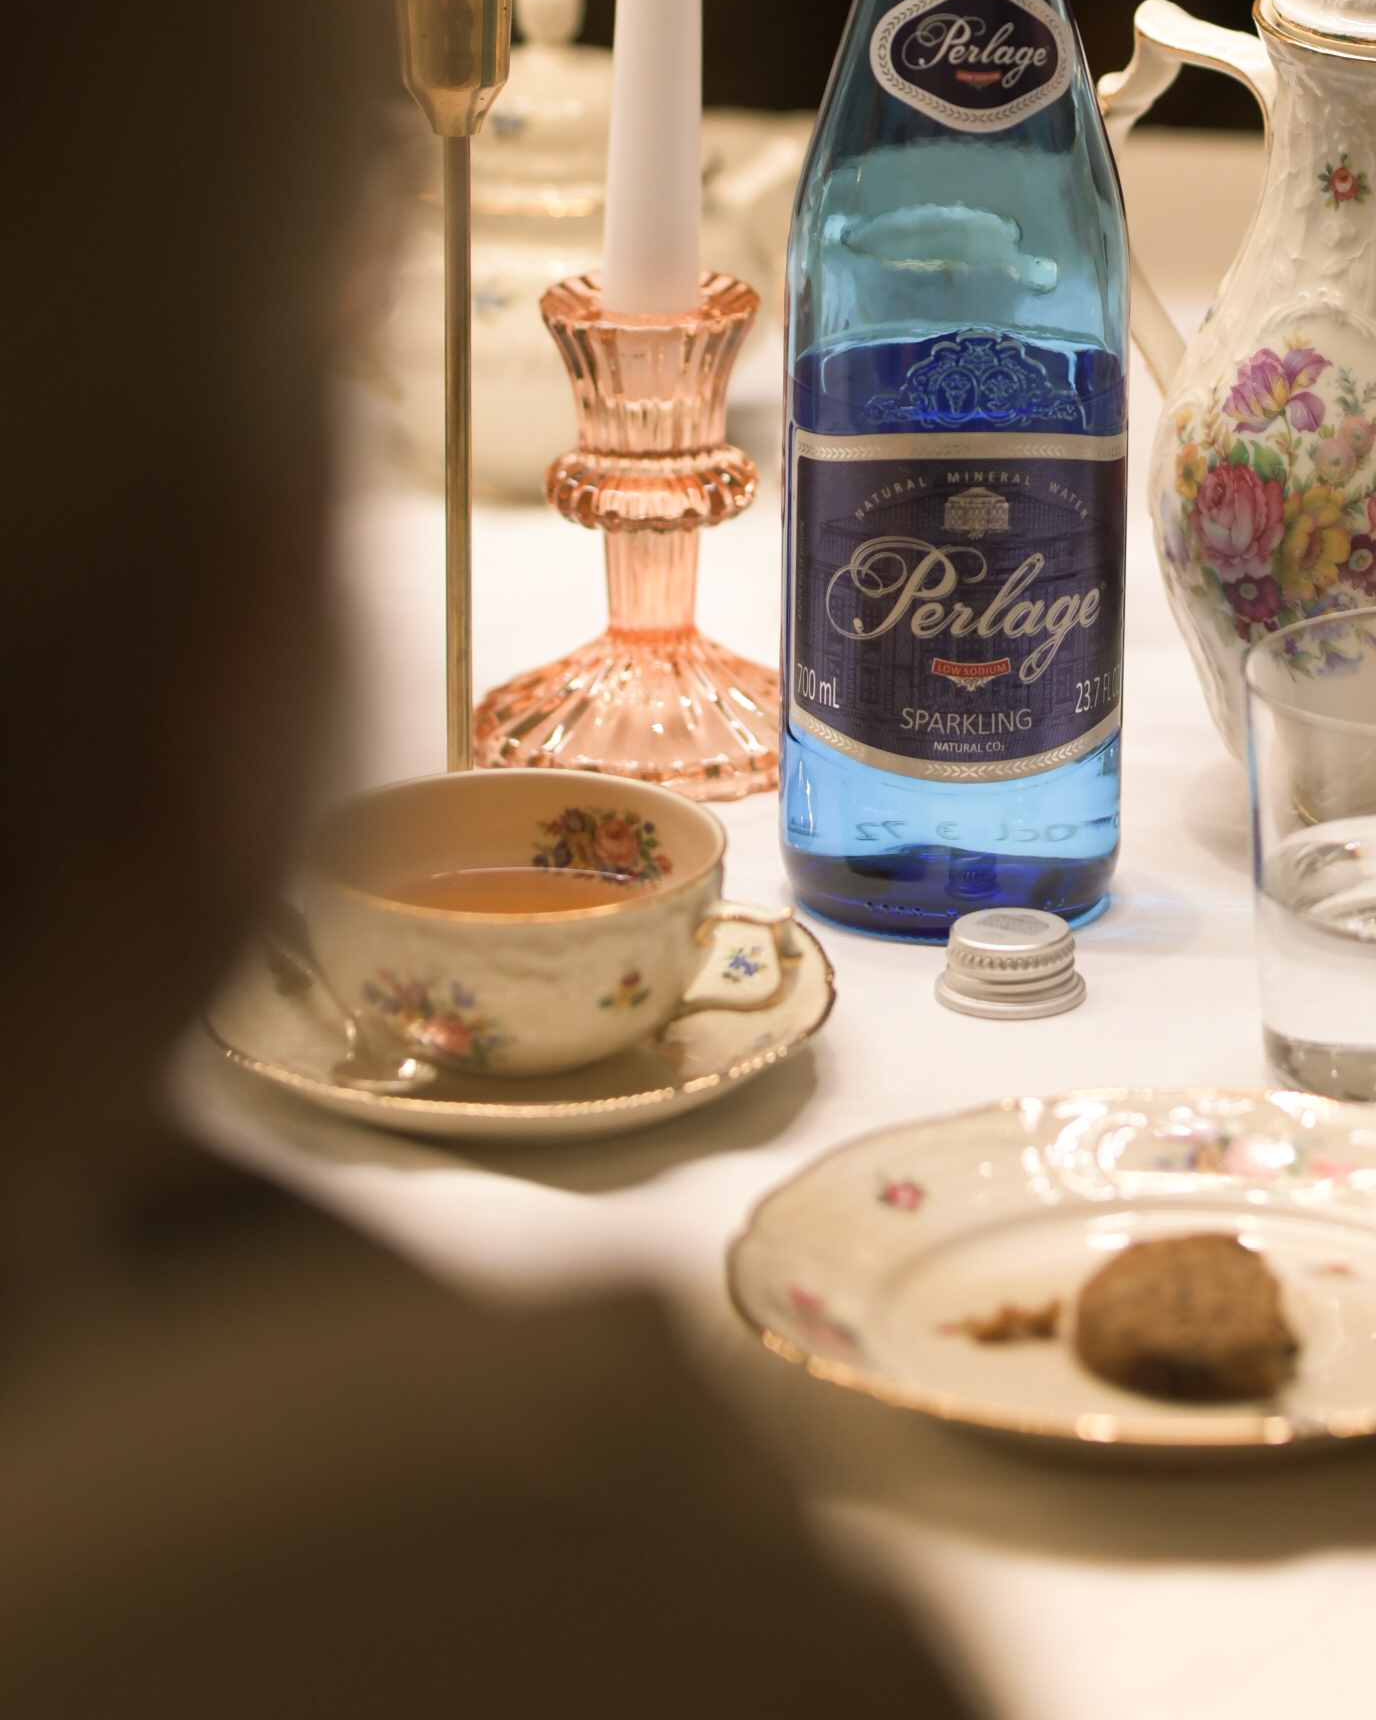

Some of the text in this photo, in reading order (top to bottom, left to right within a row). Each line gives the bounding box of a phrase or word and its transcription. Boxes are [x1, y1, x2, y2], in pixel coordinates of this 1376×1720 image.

[901, 13, 1047, 89] Perlage
[854, 471, 1089, 521] NATURAL MINERAL WATER
[826, 535, 1101, 684] Perlage
[797, 663, 840, 709] 700 mL
[937, 663, 1007, 676] LOW SODIUM
[1074, 676, 1101, 714] 23.7
[900, 707, 1033, 735] SPARKLING
[933, 741, 983, 753] NATURAL
